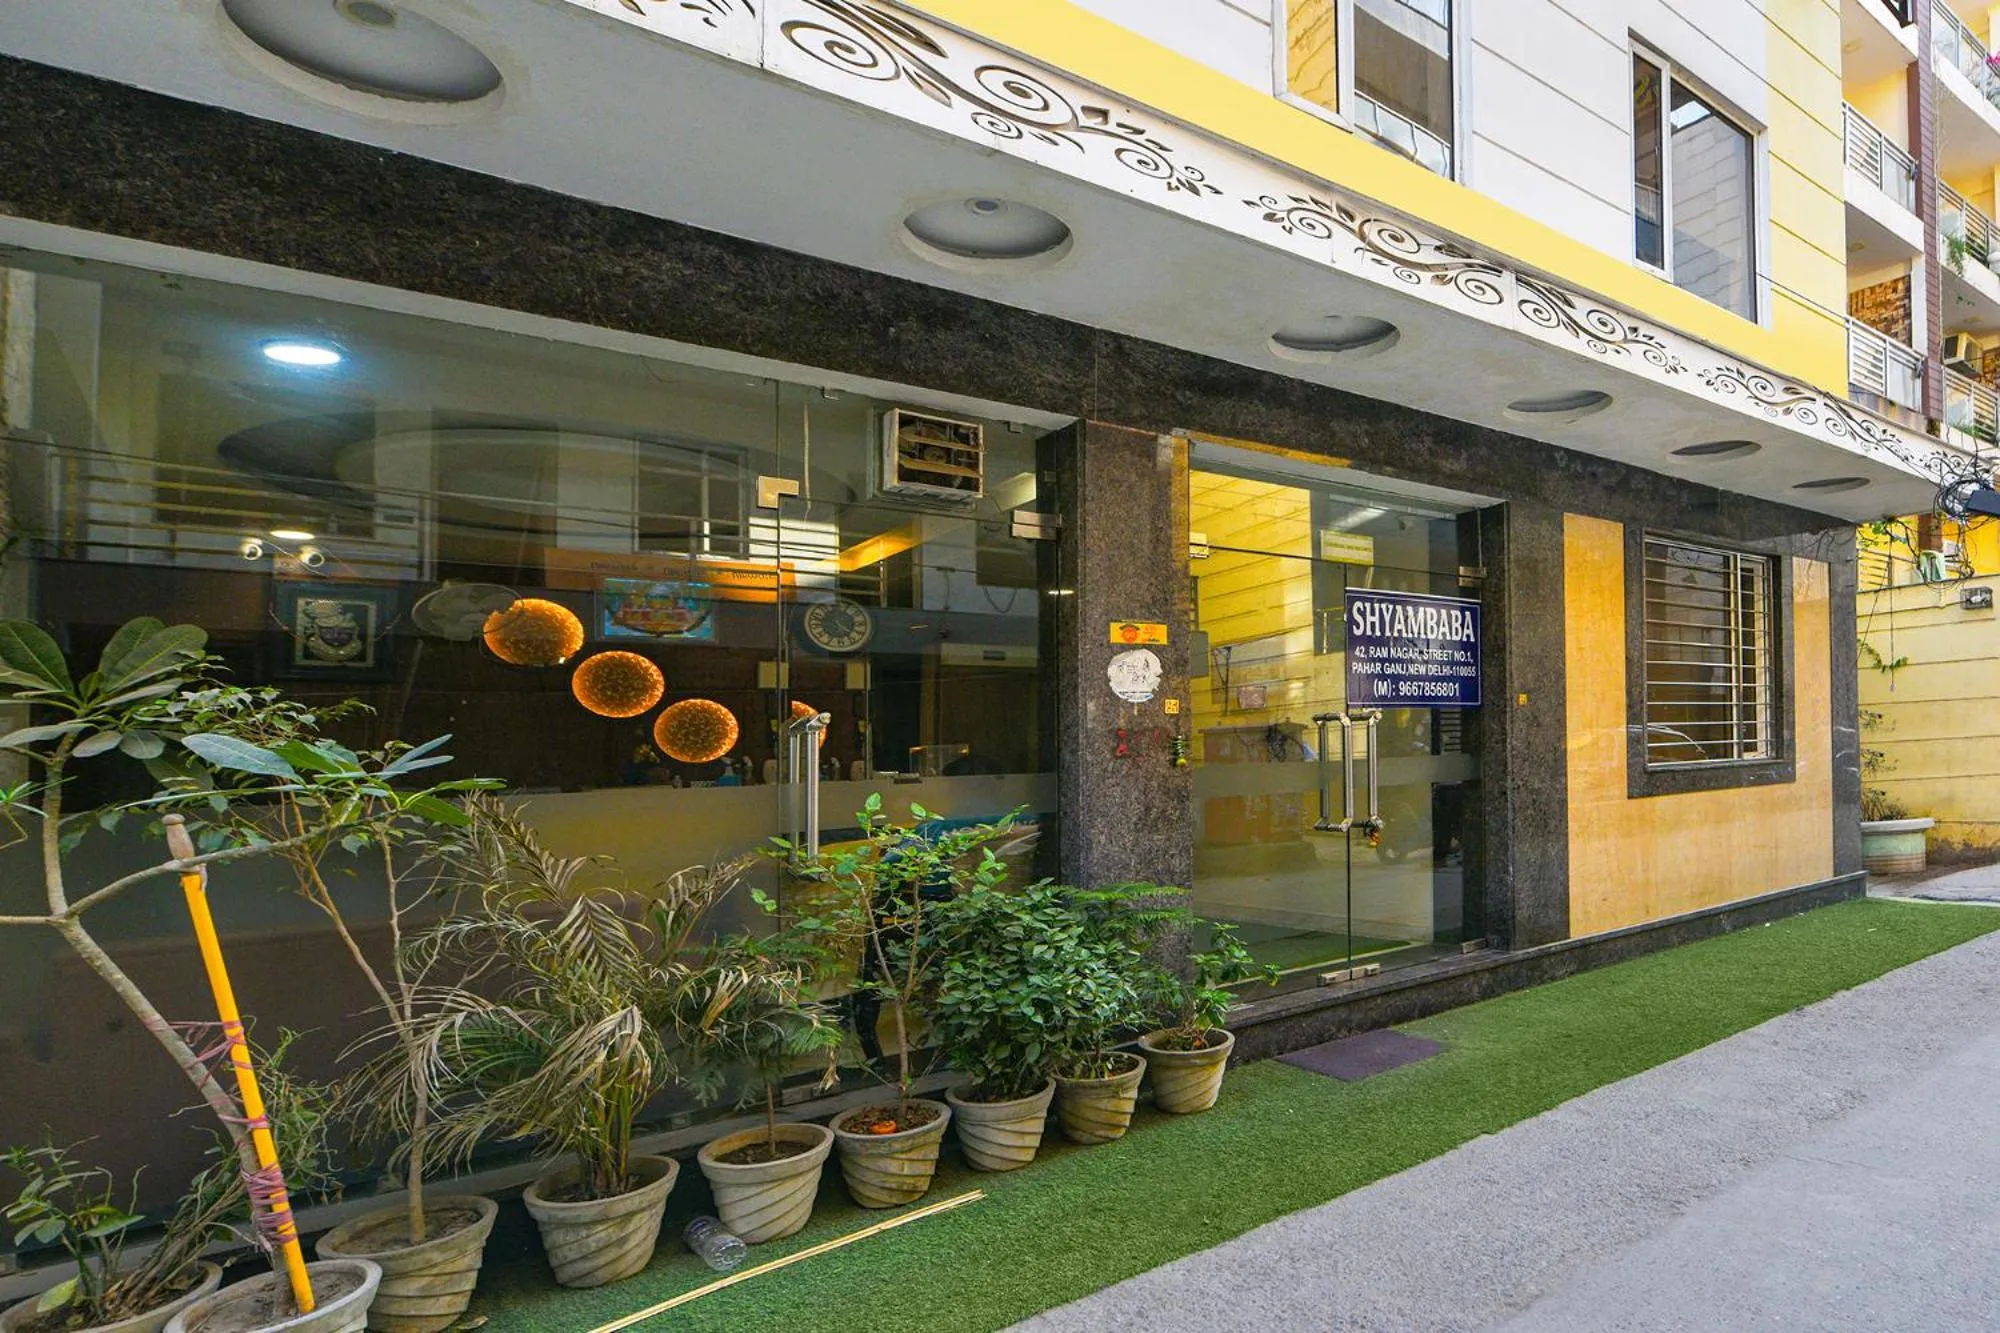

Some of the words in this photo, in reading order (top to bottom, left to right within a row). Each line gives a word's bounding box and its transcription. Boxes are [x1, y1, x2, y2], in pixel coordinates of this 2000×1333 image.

[1352, 600, 1475, 642] SHYAMBABA
[1354, 645, 1367, 659] 42,
[1369, 646, 1389, 658] RAM
[1390, 647, 1422, 661] NAGAR,
[1423, 649, 1453, 661] STREET
[1352, 662, 1382, 674] PAHAR
[1374, 678, 1396, 698] (M):
[1399, 681, 1460, 697] 9667856801
